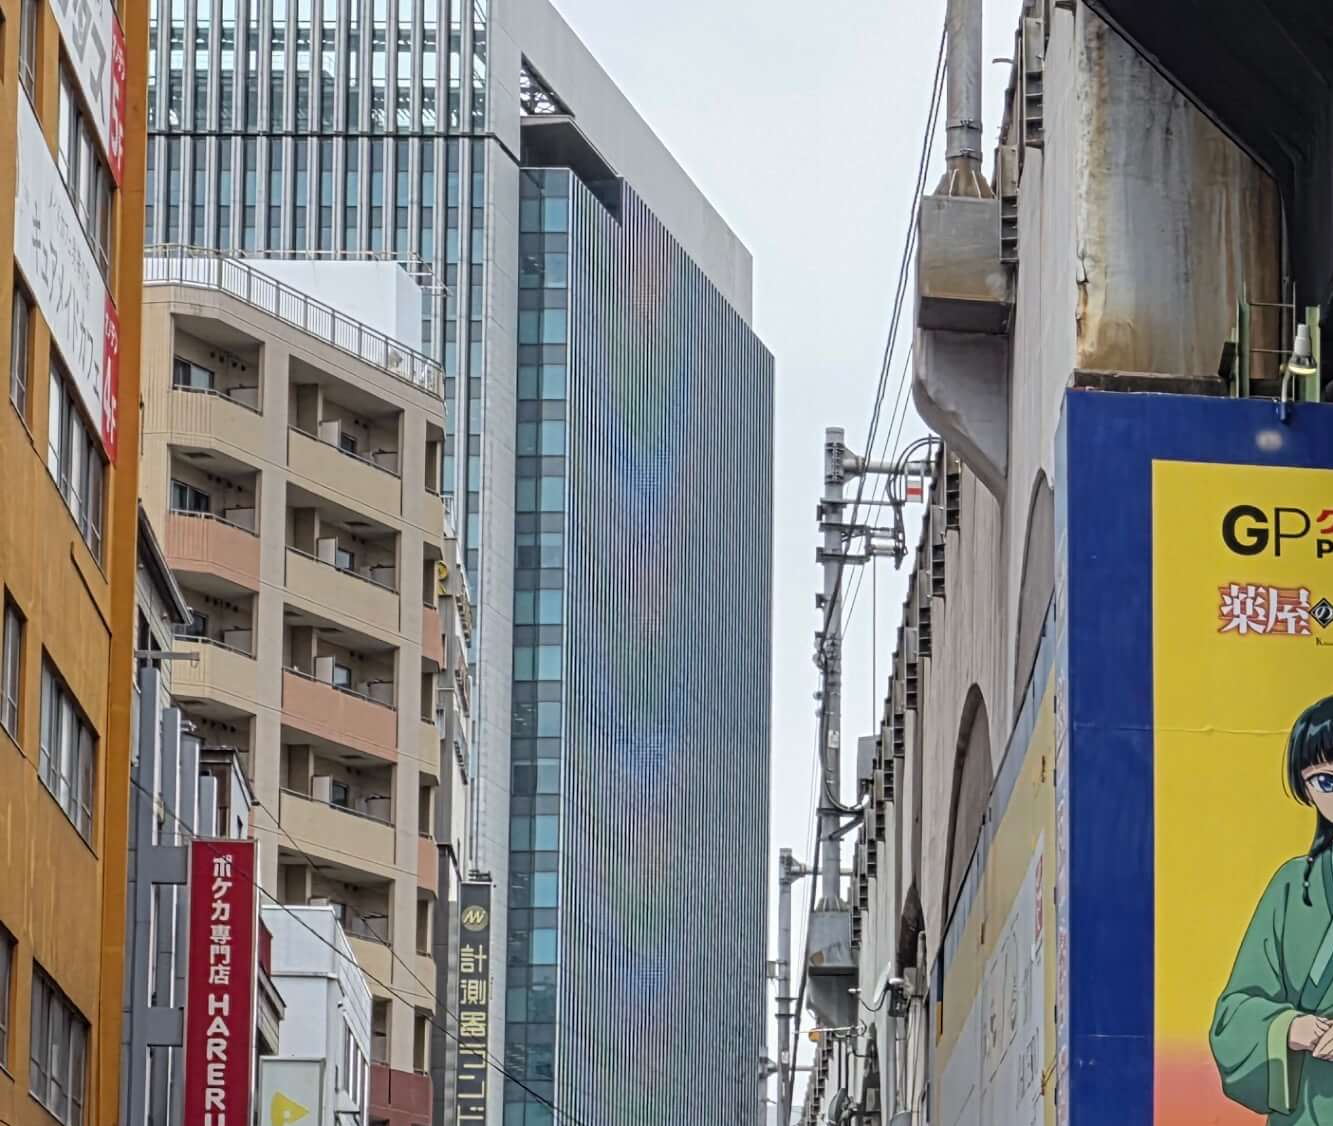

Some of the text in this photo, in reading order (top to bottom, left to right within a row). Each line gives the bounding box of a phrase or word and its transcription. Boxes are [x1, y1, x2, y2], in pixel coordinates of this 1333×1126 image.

[1222, 505, 1311, 557] GP
[209, 855, 232, 985] ポケカ専門店
